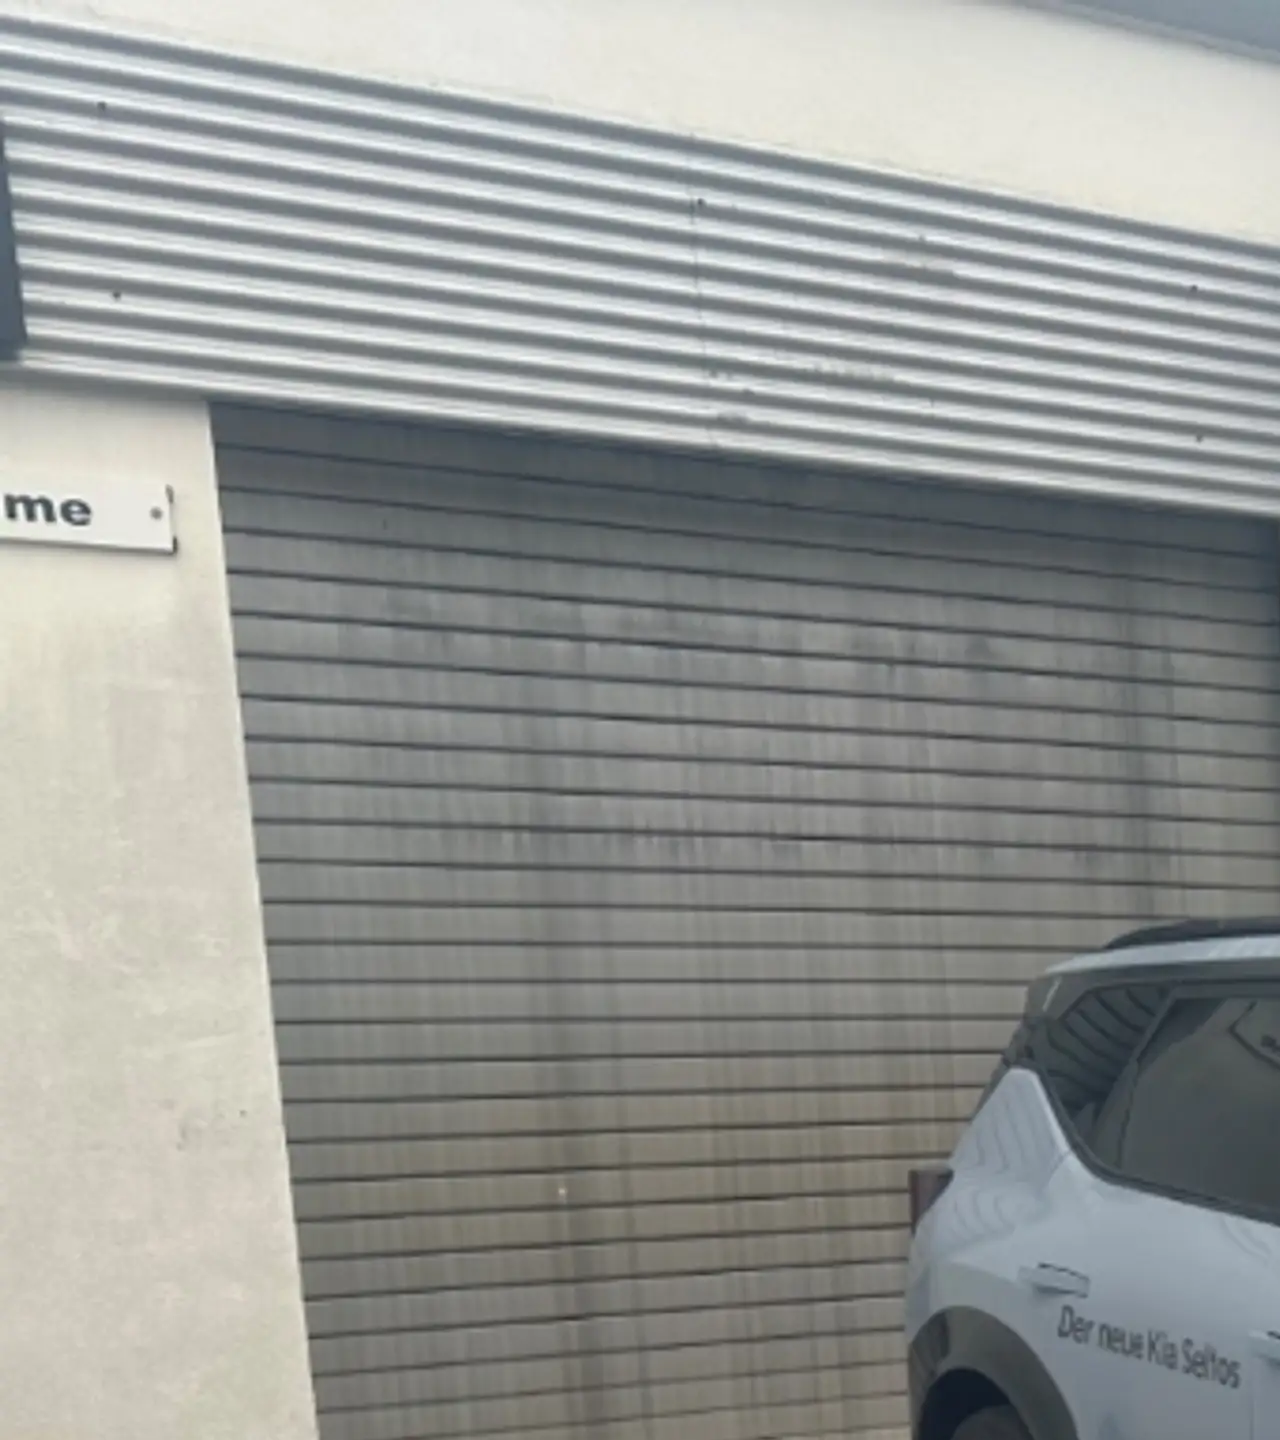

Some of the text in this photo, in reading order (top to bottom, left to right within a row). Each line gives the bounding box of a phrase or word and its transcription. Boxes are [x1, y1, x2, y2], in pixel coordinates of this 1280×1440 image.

[1057, 1304, 1243, 1390] Der neue Kia Seltos
